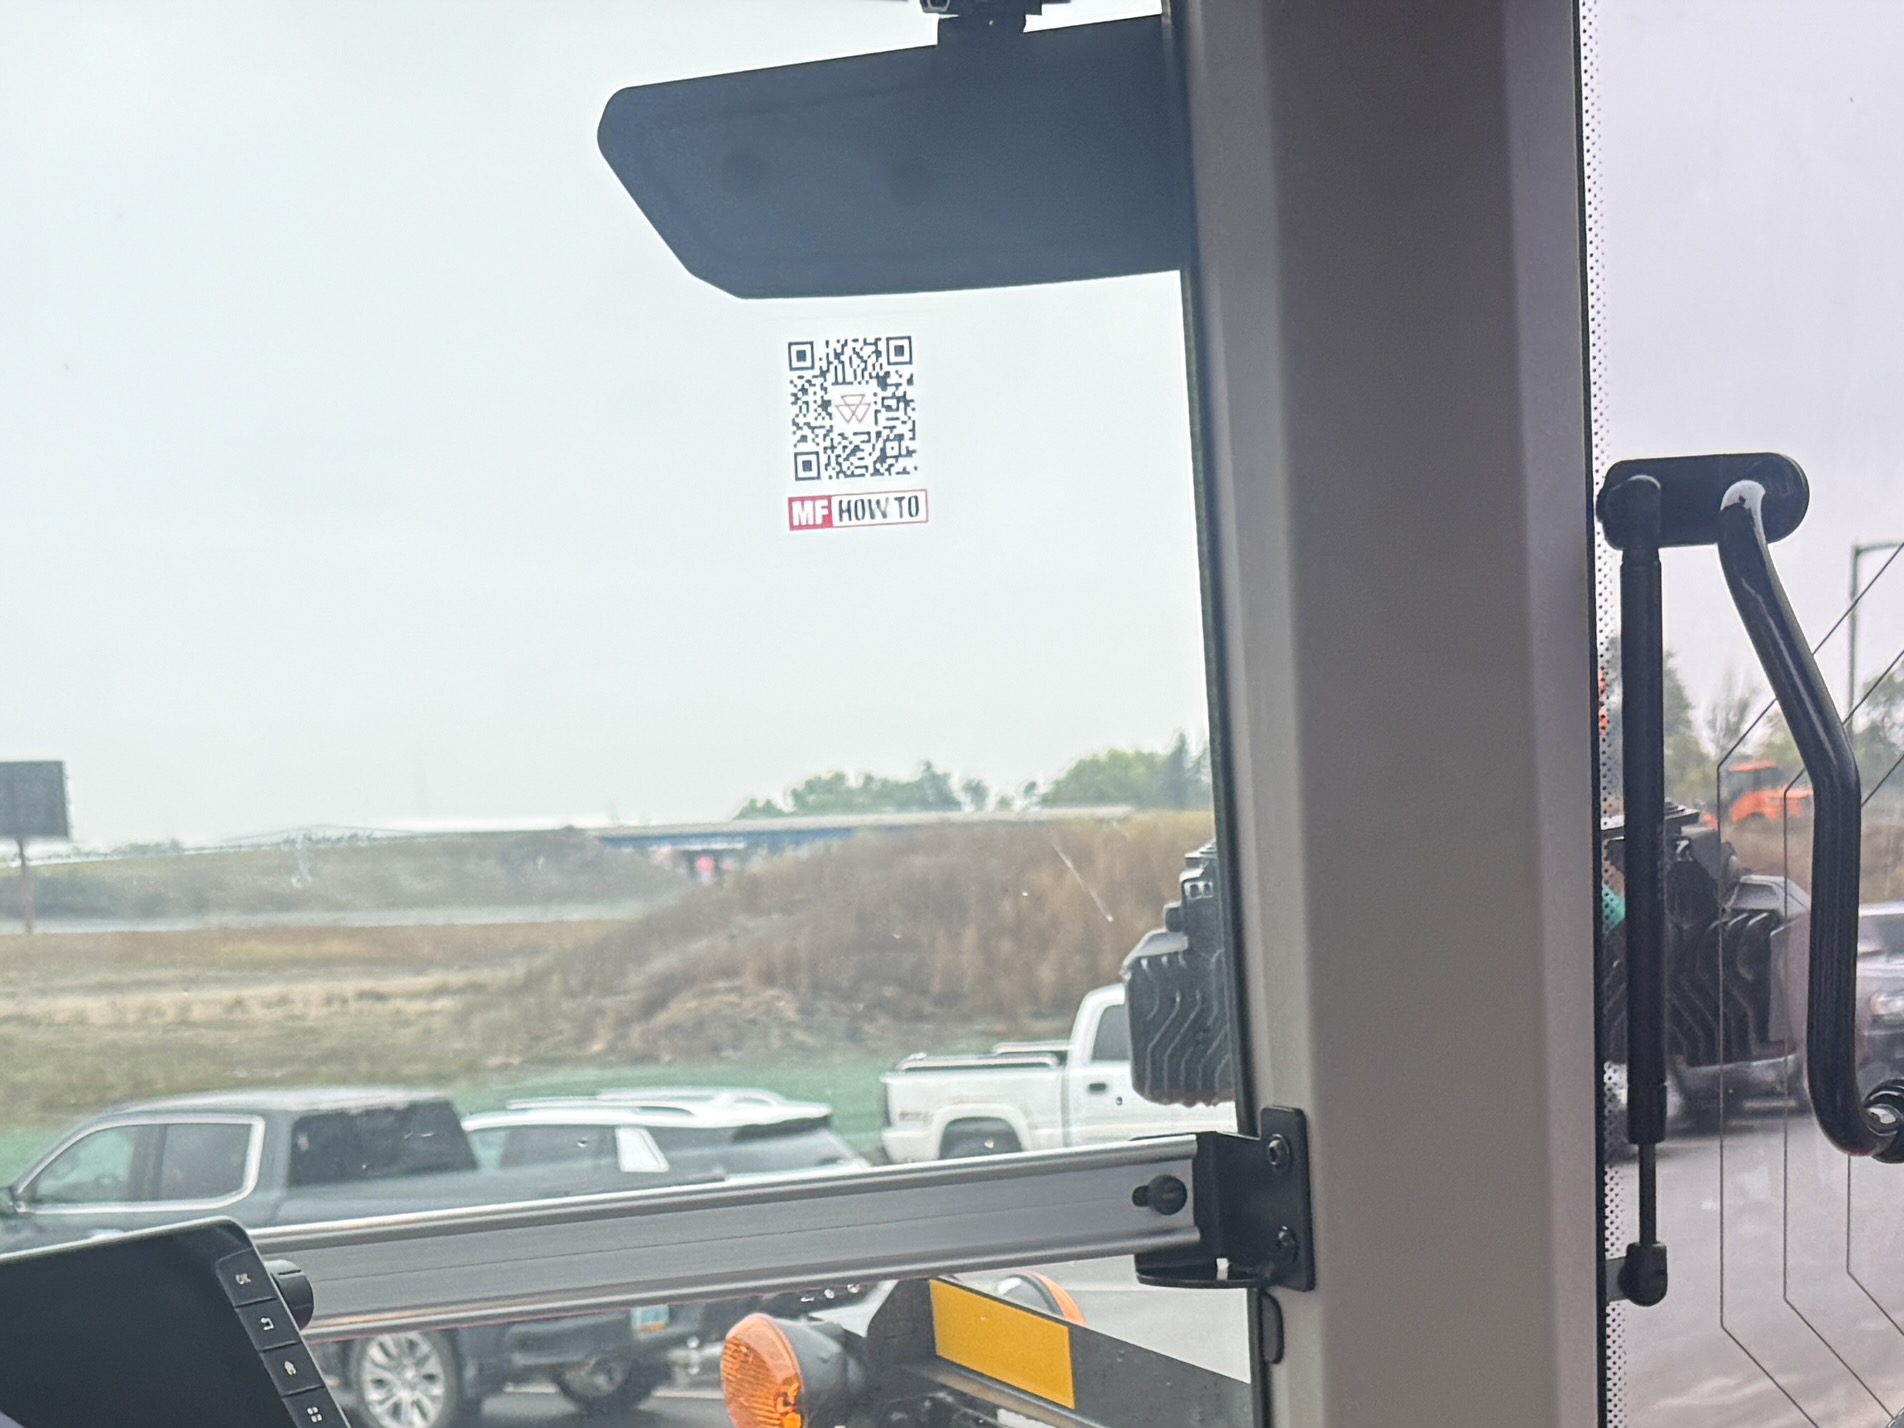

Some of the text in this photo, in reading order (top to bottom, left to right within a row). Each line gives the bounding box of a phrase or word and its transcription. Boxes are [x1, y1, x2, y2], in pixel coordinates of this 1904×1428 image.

[791, 494, 920, 526] MF HOW TO
